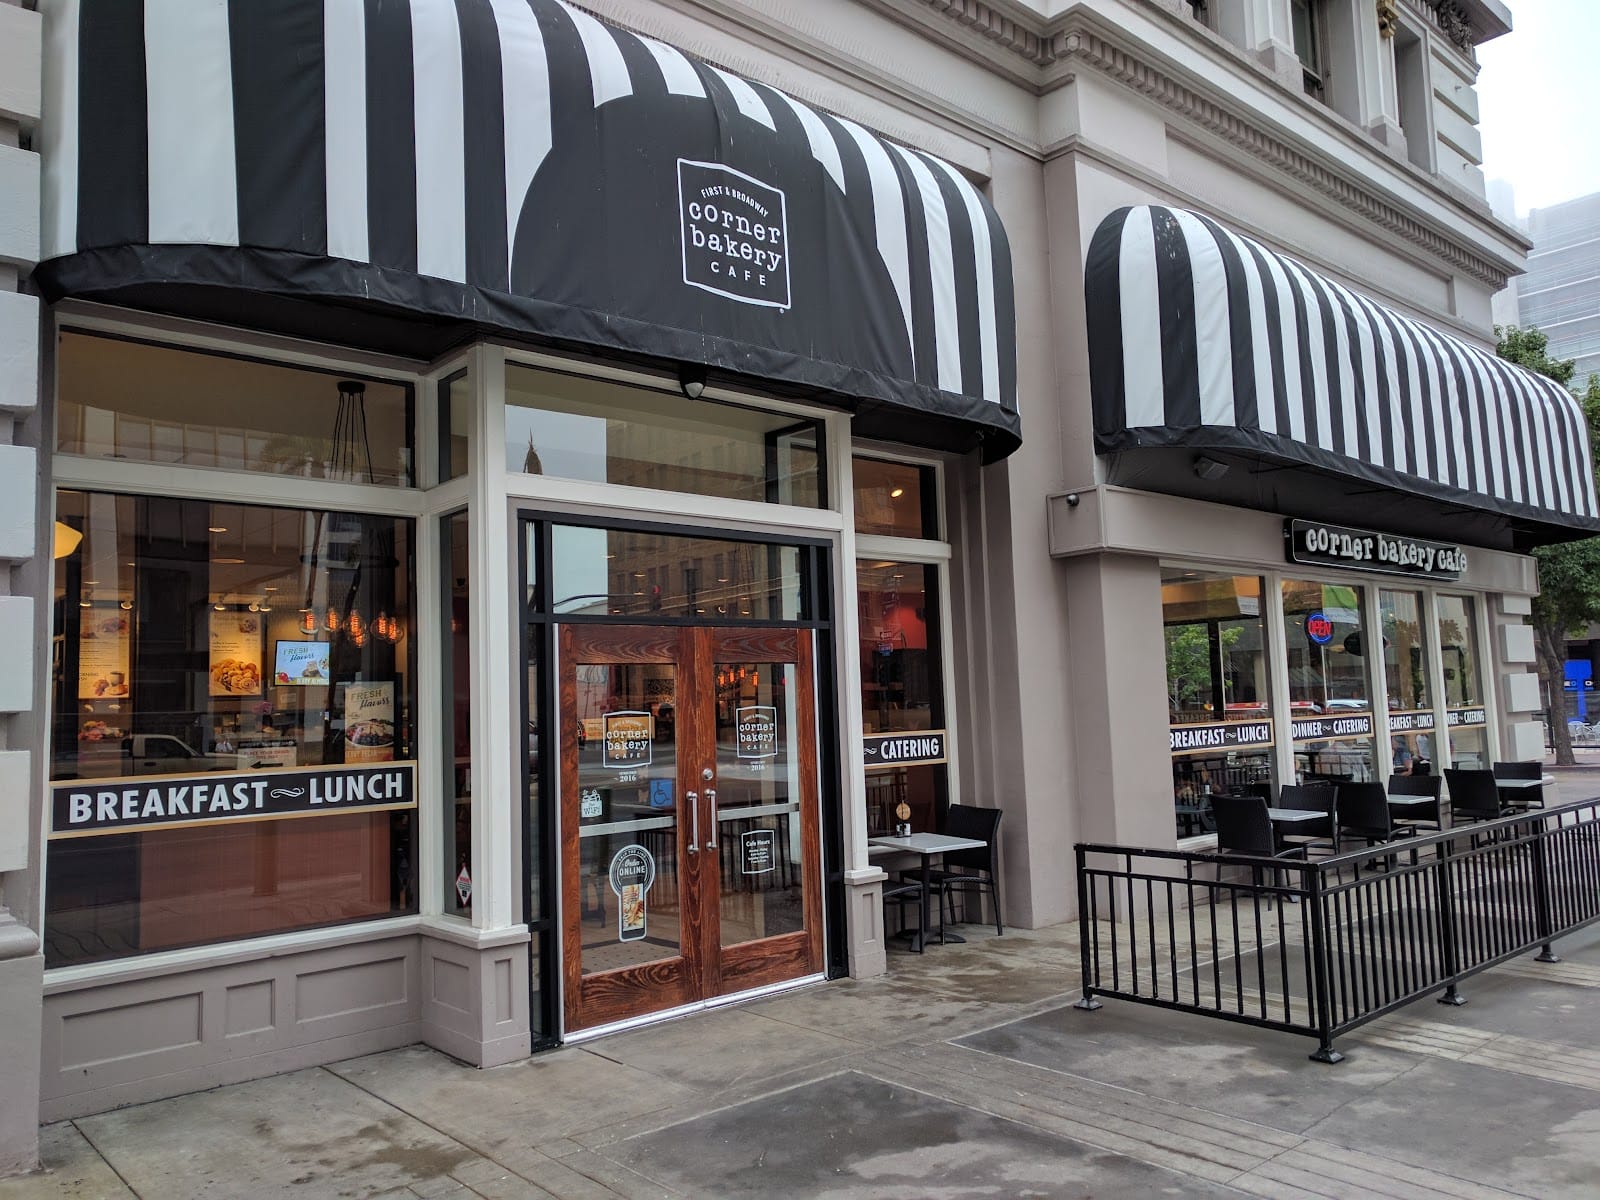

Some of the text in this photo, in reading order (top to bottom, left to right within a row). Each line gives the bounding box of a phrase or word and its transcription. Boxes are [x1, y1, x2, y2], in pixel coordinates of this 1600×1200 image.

[701, 186, 769, 217] FIRST & BROADWAY
[689, 202, 781, 244] corner
[690, 224, 782, 272] bakery
[710, 261, 766, 286] CAFE
[1306, 528, 1468, 572] corner bakery cafe
[1308, 620, 1331, 635] OPEN
[283, 647, 309, 655] FRESH
[351, 690, 382, 701] FRESH
[1389, 714, 1433, 729] EAKFAST LUNCH
[1464, 710, 1485, 724] CATERING
[607, 729, 649, 739] corner
[739, 722, 775, 732] corner
[1237, 725, 1269, 742] LUNCH
[1292, 718, 1369, 738] DINNER CATERING
[607, 740, 649, 751] bakery
[739, 733, 775, 743] bakery
[880, 738, 940, 760] CATERING
[69, 773, 403, 823] BREAKFAST LUNCH
[624, 859, 640, 867] Order
[619, 866, 646, 876] ONLINE
